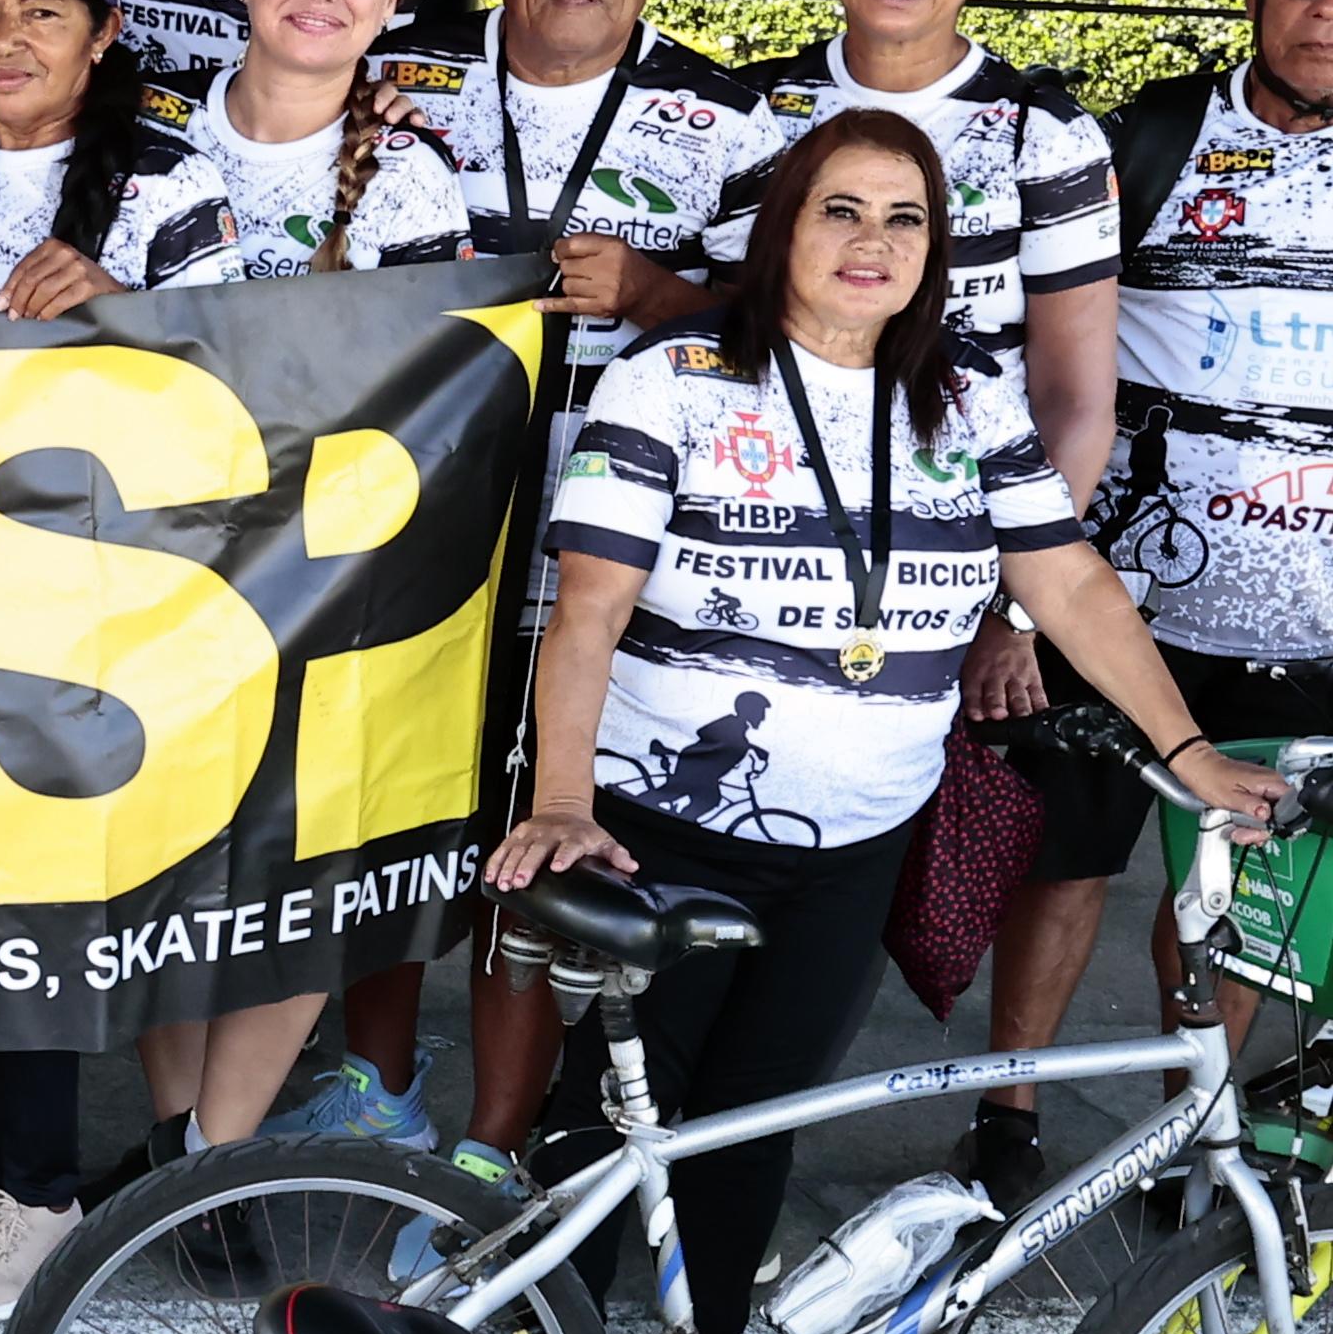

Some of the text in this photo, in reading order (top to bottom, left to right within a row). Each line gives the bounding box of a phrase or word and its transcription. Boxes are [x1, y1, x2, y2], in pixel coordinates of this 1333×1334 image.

[630, 121, 675, 147] FPC
[722, 503, 793, 530] HBP
[1206, 494, 1233, 521] O
[675, 548, 833, 581] FESTIVAL
[778, 606, 947, 630] DE SNTOS
[84, 902, 267, 990] SKATE
[278, 889, 313, 943] E
[332, 845, 481, 934] PATINS
[1019, 1103, 1202, 1264] SUNDOWN
